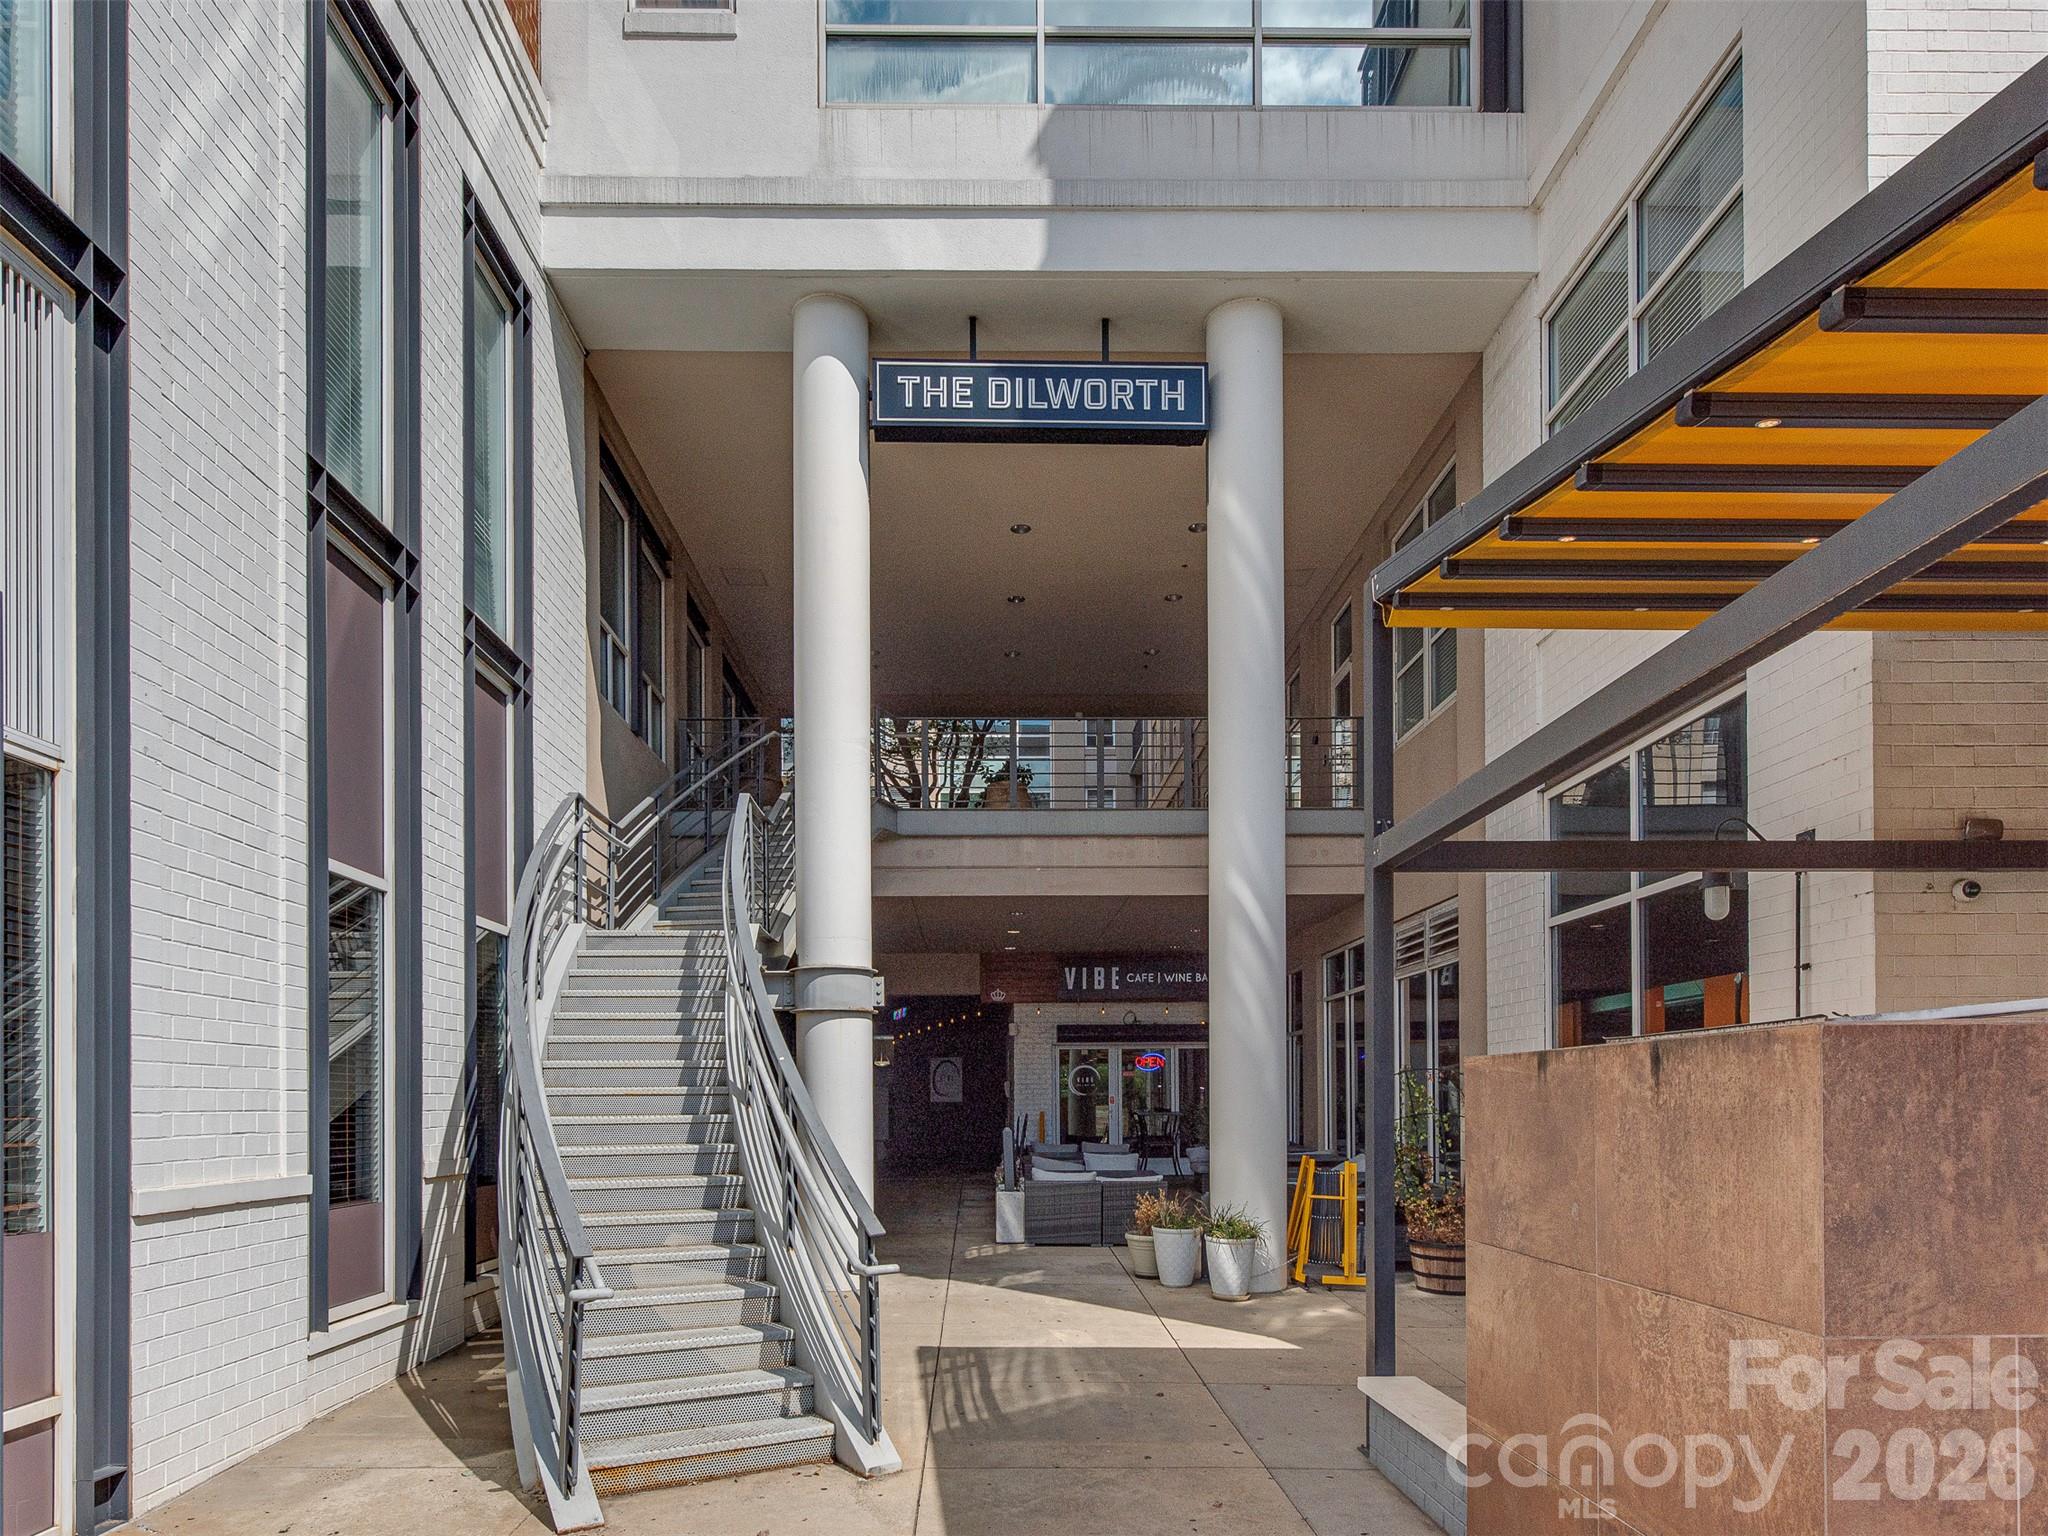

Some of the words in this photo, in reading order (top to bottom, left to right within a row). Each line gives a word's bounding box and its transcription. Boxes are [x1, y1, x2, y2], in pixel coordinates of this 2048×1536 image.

[898, 376, 974, 408] THE
[988, 377, 1185, 411] DILWORTH
[1064, 967, 1120, 990] VIBE
[1126, 973, 1154, 983] CAFE
[1163, 973, 1192, 983] WINE
[1195, 973, 1209, 983] BA
[1135, 1056, 1166, 1068] OPEN
